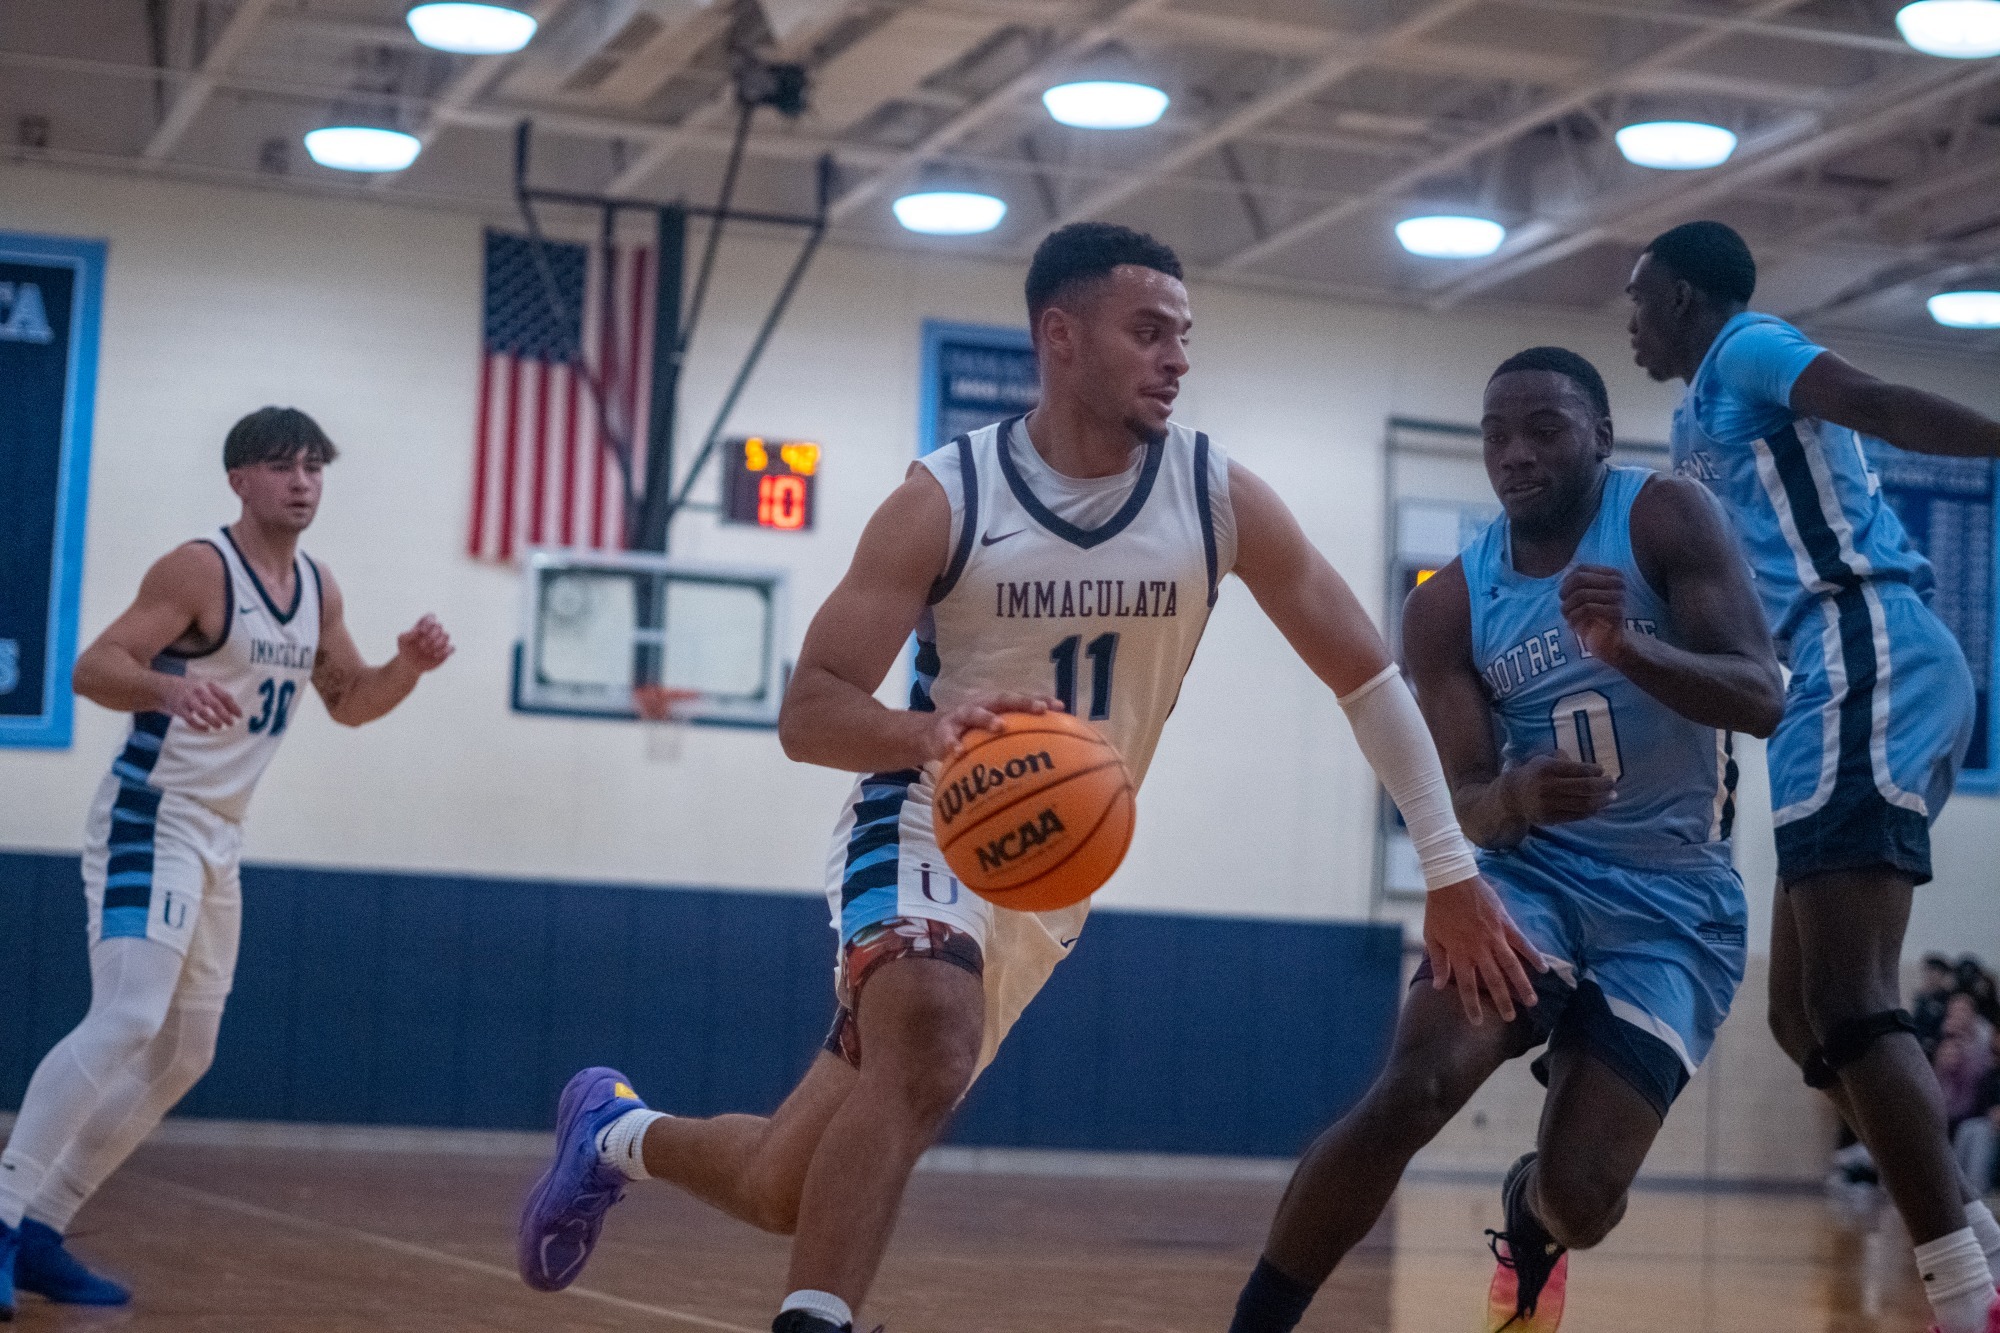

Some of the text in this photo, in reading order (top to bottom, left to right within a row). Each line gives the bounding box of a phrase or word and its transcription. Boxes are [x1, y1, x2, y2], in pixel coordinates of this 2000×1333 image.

[757, 475, 806, 530] 10
[996, 580, 1177, 618] IMMACULATA
[1050, 631, 1120, 721] 11
[1483, 627, 1567, 701] NOTRE
[249, 678, 296, 736] 30
[1549, 689, 1624, 783] 0
[938, 750, 1055, 824] Wilson
[975, 808, 1065, 872] NCAA
